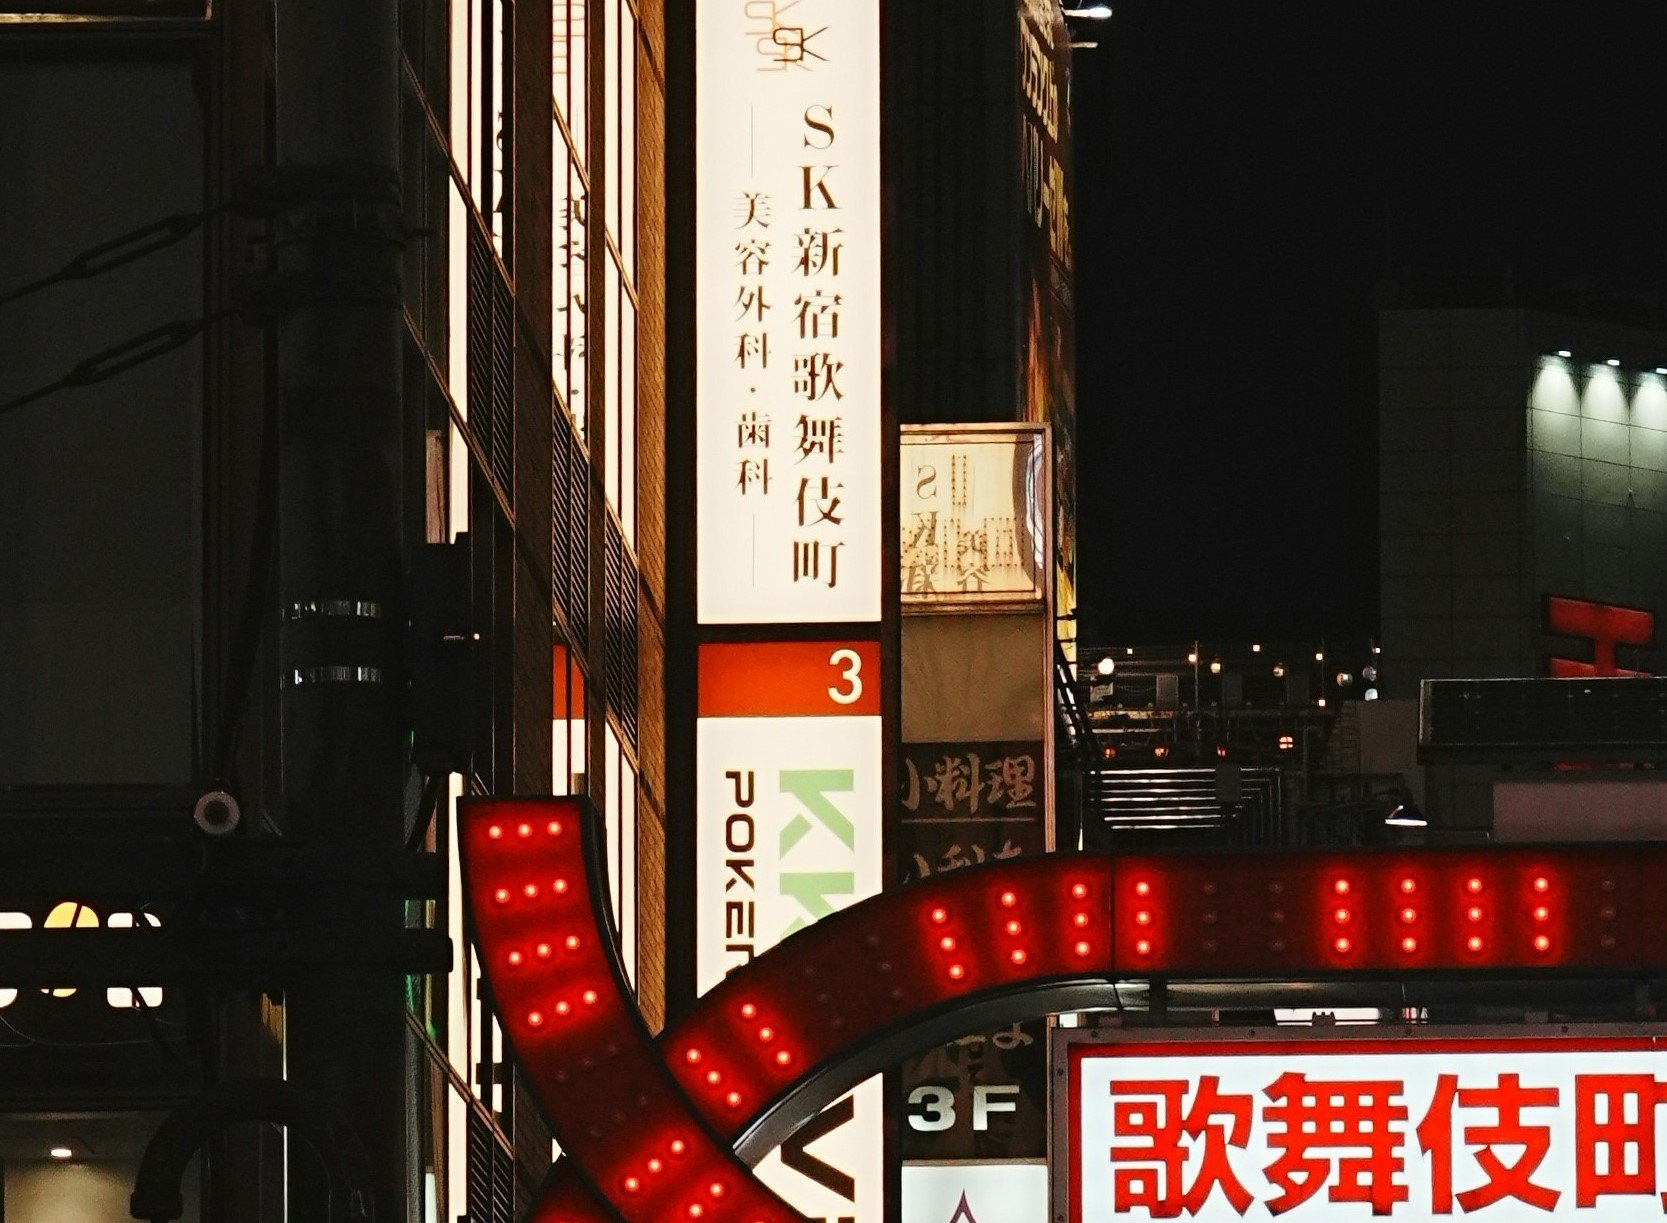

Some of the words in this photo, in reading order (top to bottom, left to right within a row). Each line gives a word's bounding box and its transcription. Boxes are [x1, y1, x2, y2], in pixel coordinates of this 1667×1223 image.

[732, 190, 773, 497] 美容外科・歯科
[790, 103, 846, 589] SK新宿歌舞伎町
[827, 648, 864, 705] 3
[906, 1084, 1020, 1132] 3F
